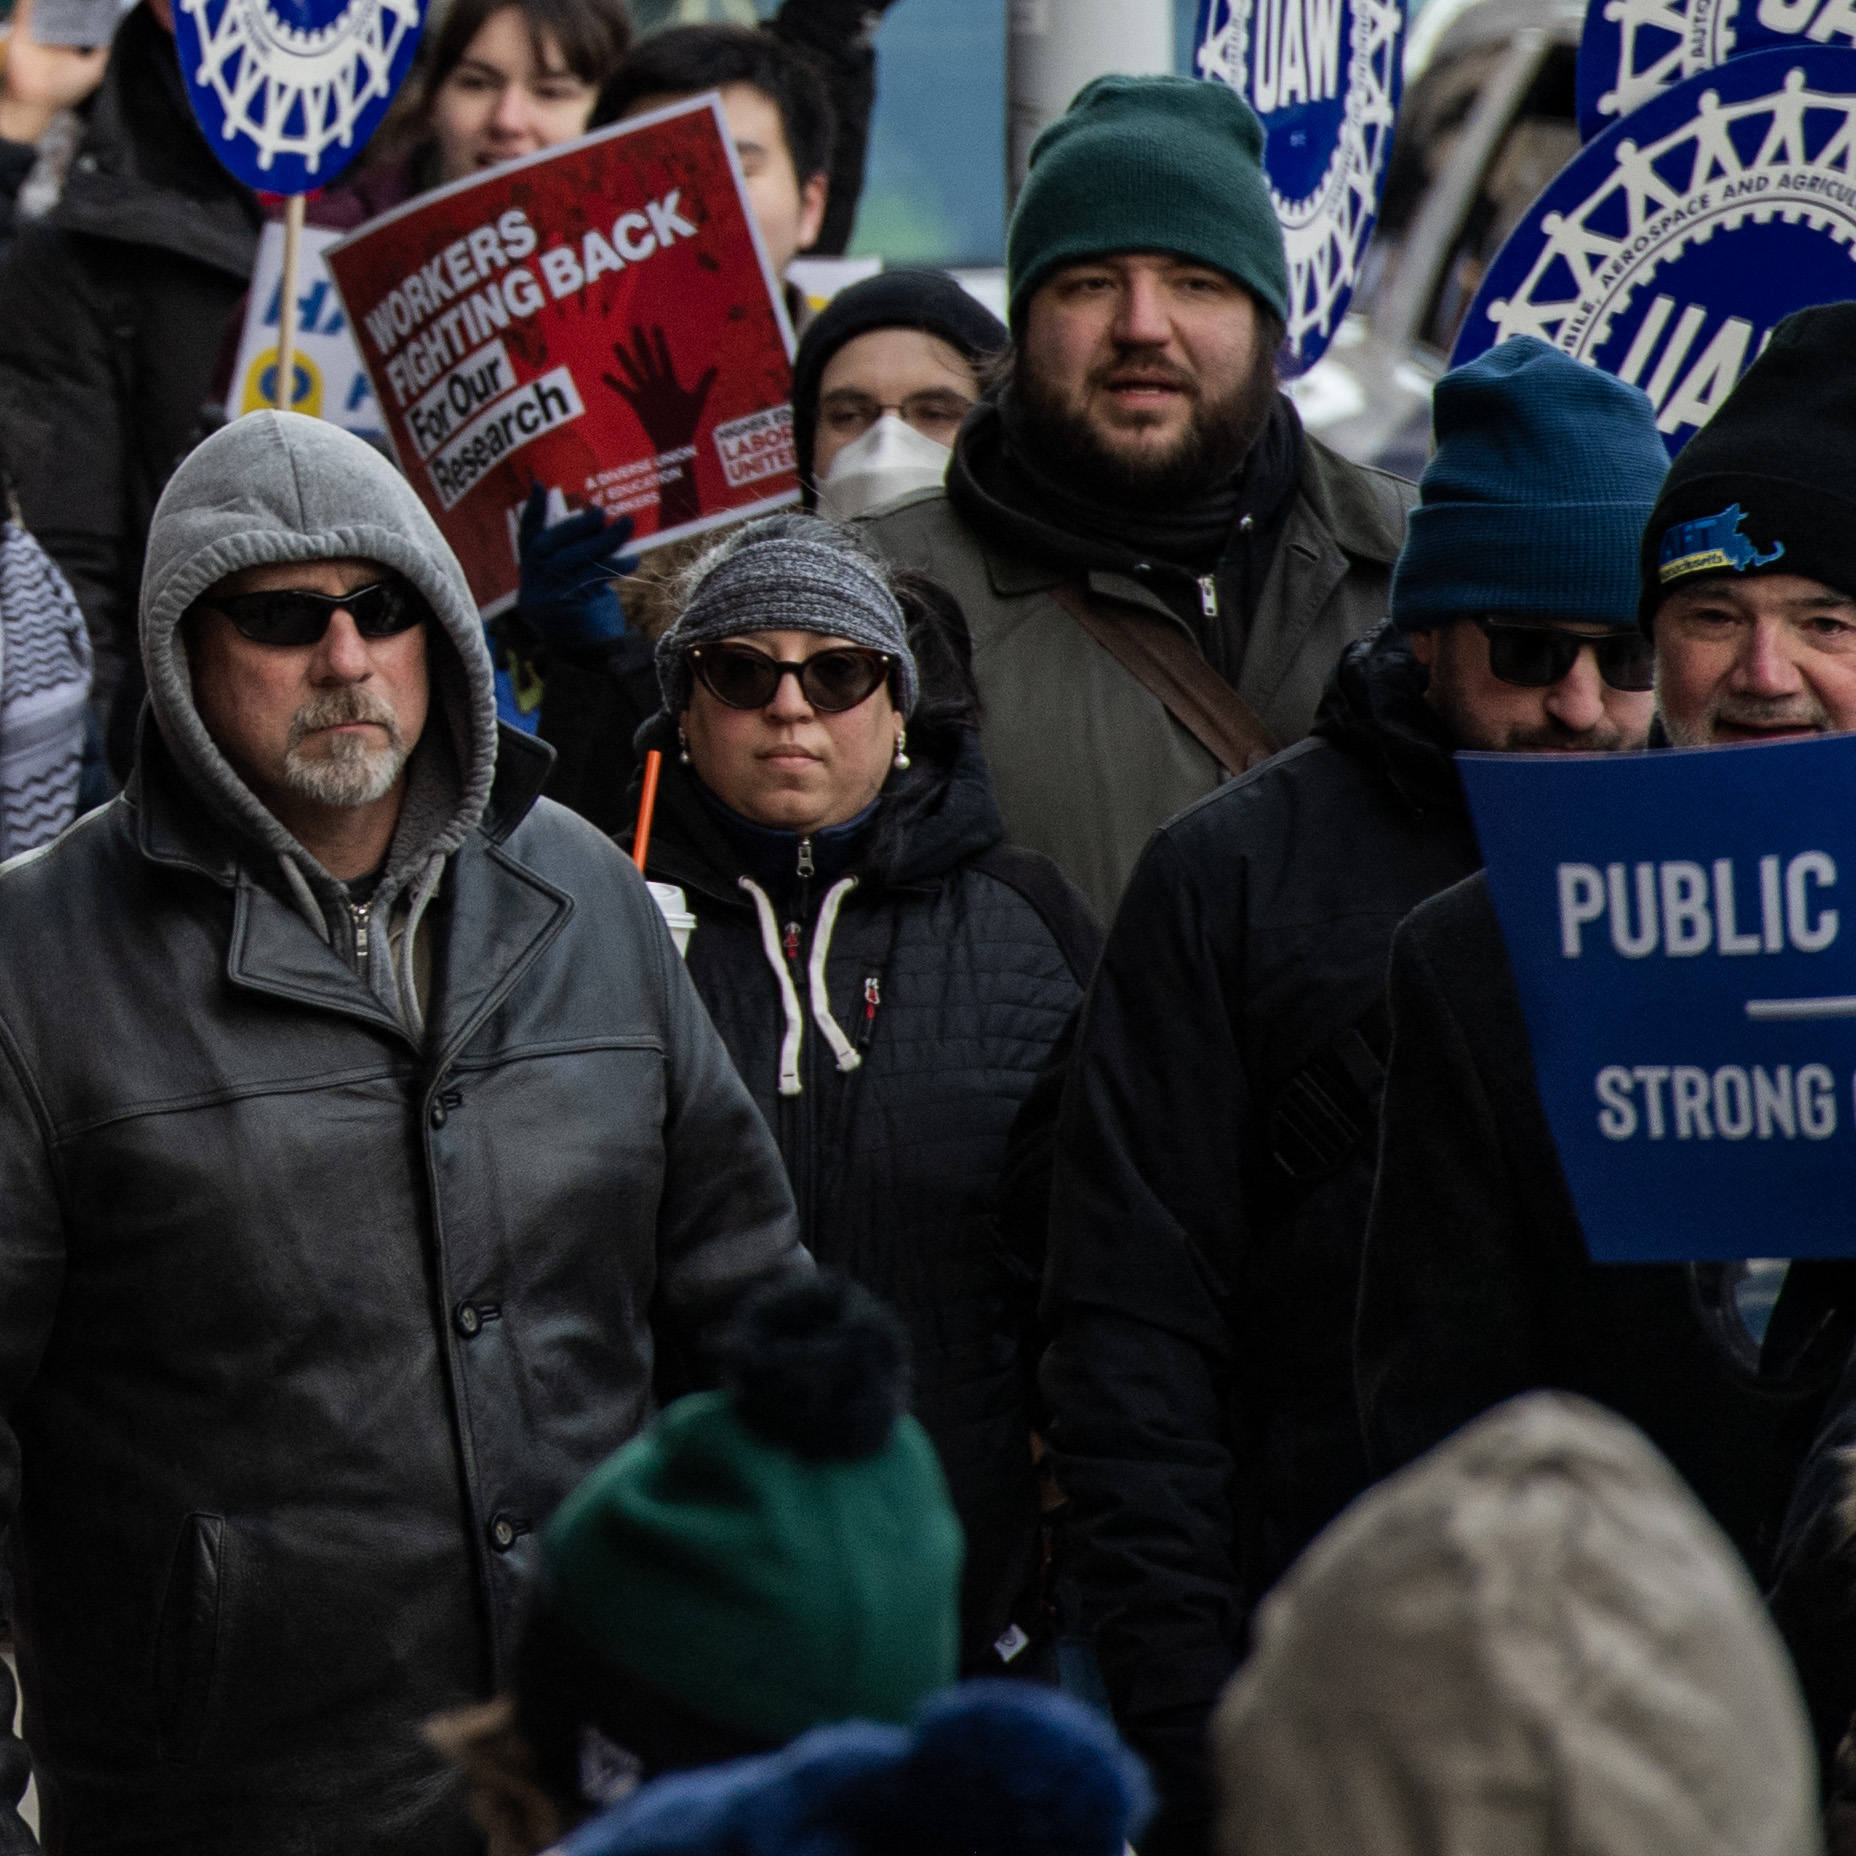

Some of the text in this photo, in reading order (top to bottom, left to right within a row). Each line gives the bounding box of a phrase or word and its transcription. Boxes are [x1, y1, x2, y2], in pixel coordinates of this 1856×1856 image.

[363, 209, 537, 355] WORKERS
[1599, 193, 1712, 290] AEROSPACE
[1723, 175, 1770, 202] AND
[386, 267, 546, 408] FIGHTING
[539, 186, 699, 301] BACK
[408, 400, 453, 454] For
[445, 356, 502, 417] Our
[432, 381, 571, 499] Research
[1556, 850, 1839, 959] PUBLIC
[1595, 1063, 1839, 1141] STRONG
